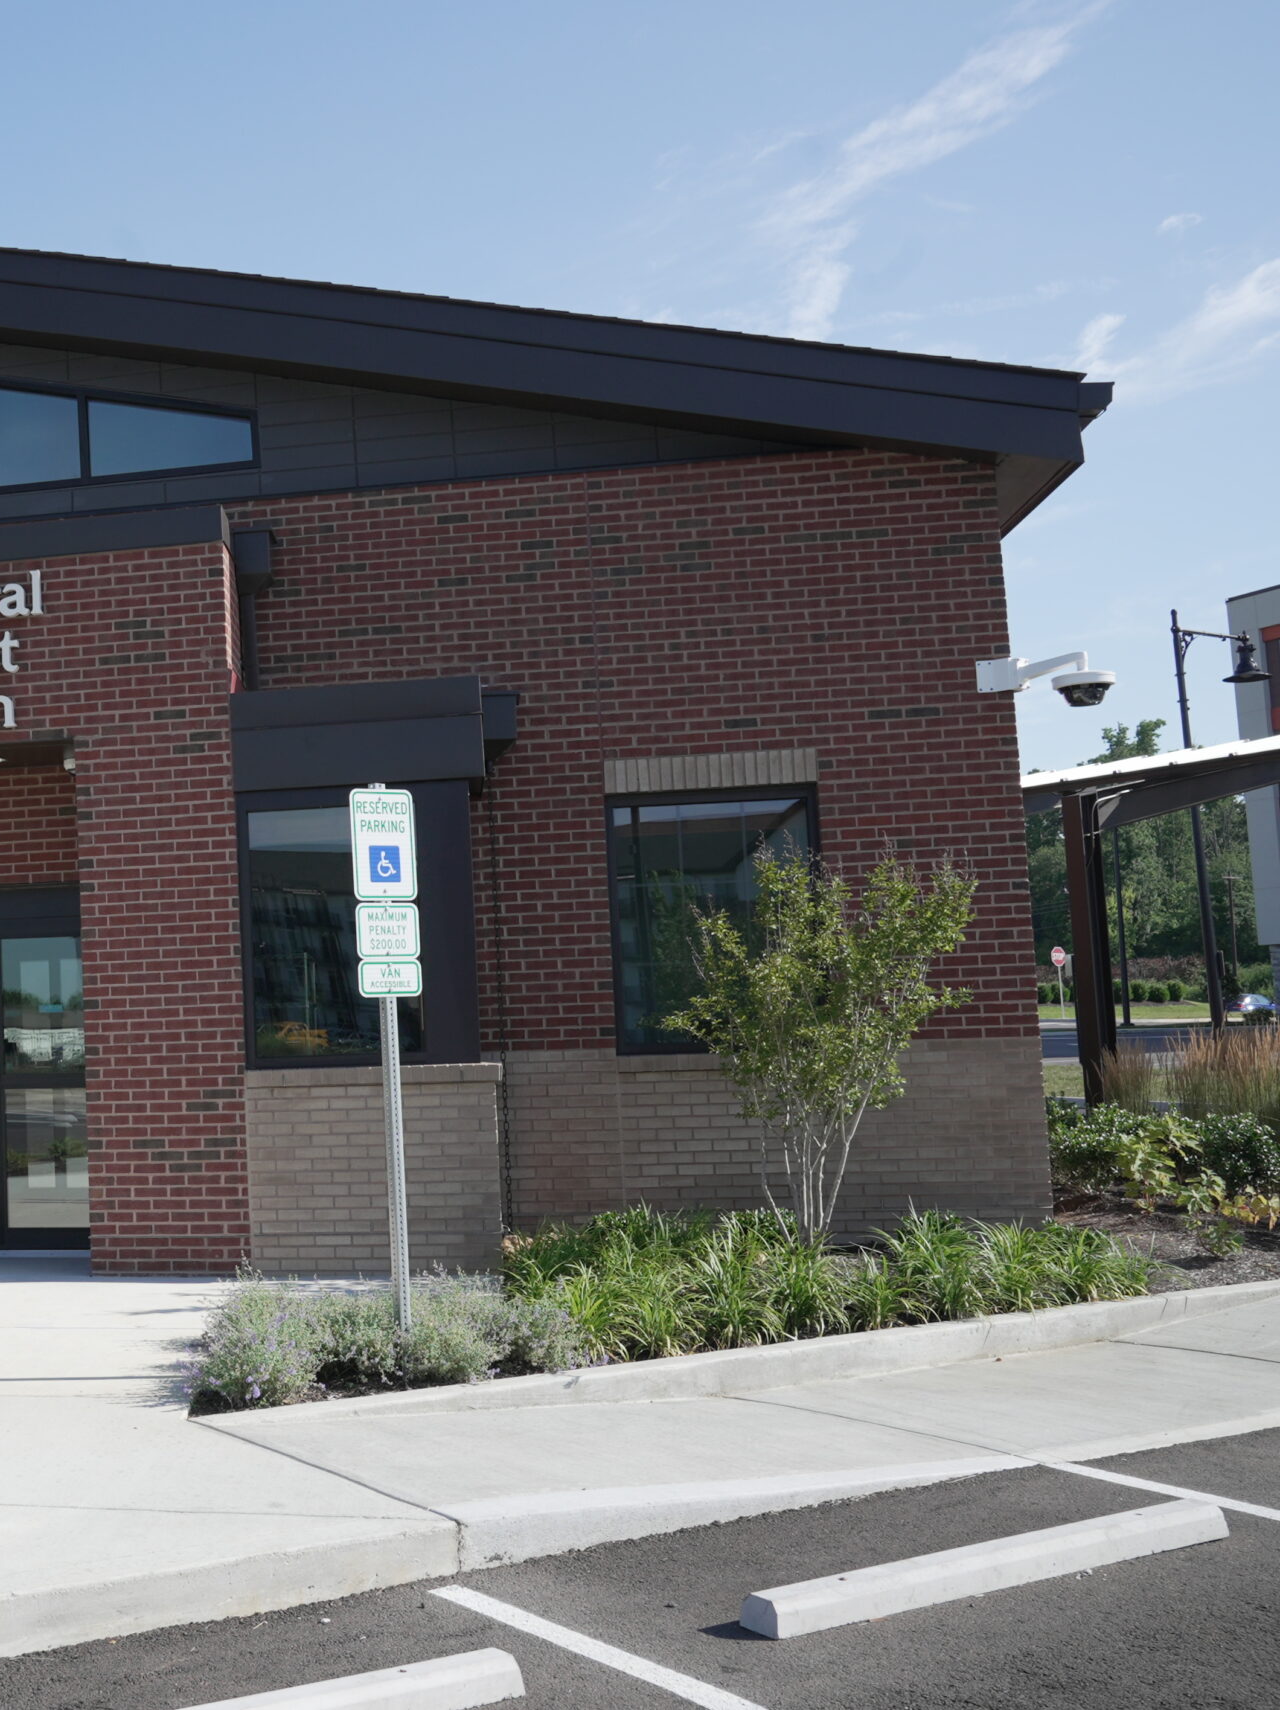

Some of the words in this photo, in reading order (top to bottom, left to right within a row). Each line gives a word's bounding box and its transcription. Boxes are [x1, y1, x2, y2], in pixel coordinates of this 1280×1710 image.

[355, 801, 408, 815] RESERVED
[360, 819, 406, 834] PARKING
[367, 912, 408, 922] MAXIMUM
[369, 925, 407, 935] PENALTY
[370, 938, 407, 950] $200.00
[380, 968, 401, 978] VAN
[370, 980, 412, 989] ACCESSIBLE
